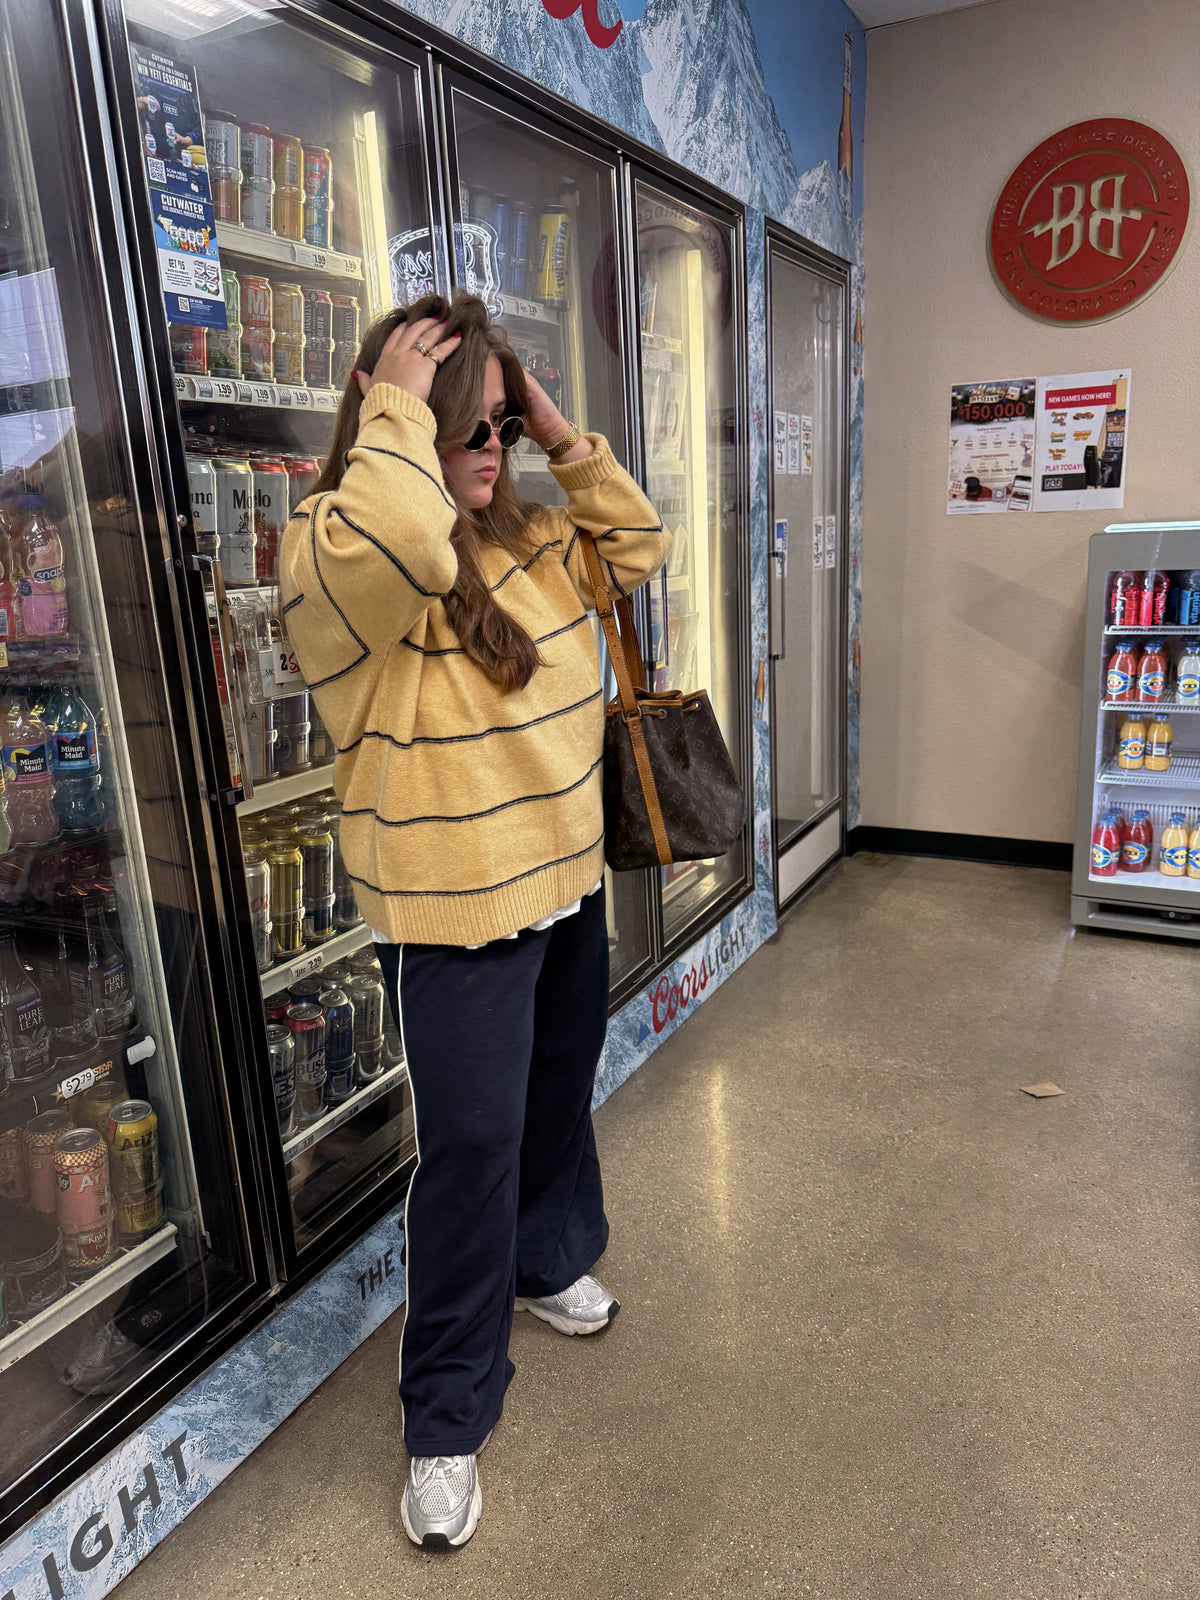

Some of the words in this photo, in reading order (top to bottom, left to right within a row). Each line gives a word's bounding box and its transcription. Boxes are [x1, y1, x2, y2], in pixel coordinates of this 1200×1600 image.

[136, 62, 149, 76] WIN
[149, 67, 162, 82] YETI
[162, 71, 193, 92] ESSENTIALS
[164, 105, 178, 115] YETI
[1122, 133, 1181, 202] BREWERY
[160, 194, 204, 215] CUTWATER
[168, 258, 177, 268] GET
[554, 241, 566, 288] TWISTED
[1001, 250, 1028, 292] FINE
[1028, 278, 1137, 313] COLORADO
[1142, 225, 1177, 278] ALES
[1048, 396, 1061, 404] NEW
[1061, 394, 1081, 403] GAMES
[1081, 393, 1096, 401] NOW
[958, 402, 1026, 421] $150,000
[1045, 464, 1060, 472] PLAY
[1061, 463, 1083, 471] TODAY!
[60, 745, 86, 753] Minute
[64, 752, 83, 760] Maid
[19, 757, 45, 766] Minute
[24, 764, 43, 773] Maid
[104, 972, 125, 986] PURE
[649, 956, 709, 1034] Coors
[708, 924, 746, 975] LIGHT
[105, 980, 126, 996] LEAF
[18, 1007, 43, 1022] PURE
[20, 1015, 45, 1031] LEAF
[92, 1060, 113, 1076] STAR
[356, 1247, 395, 1301] THE
